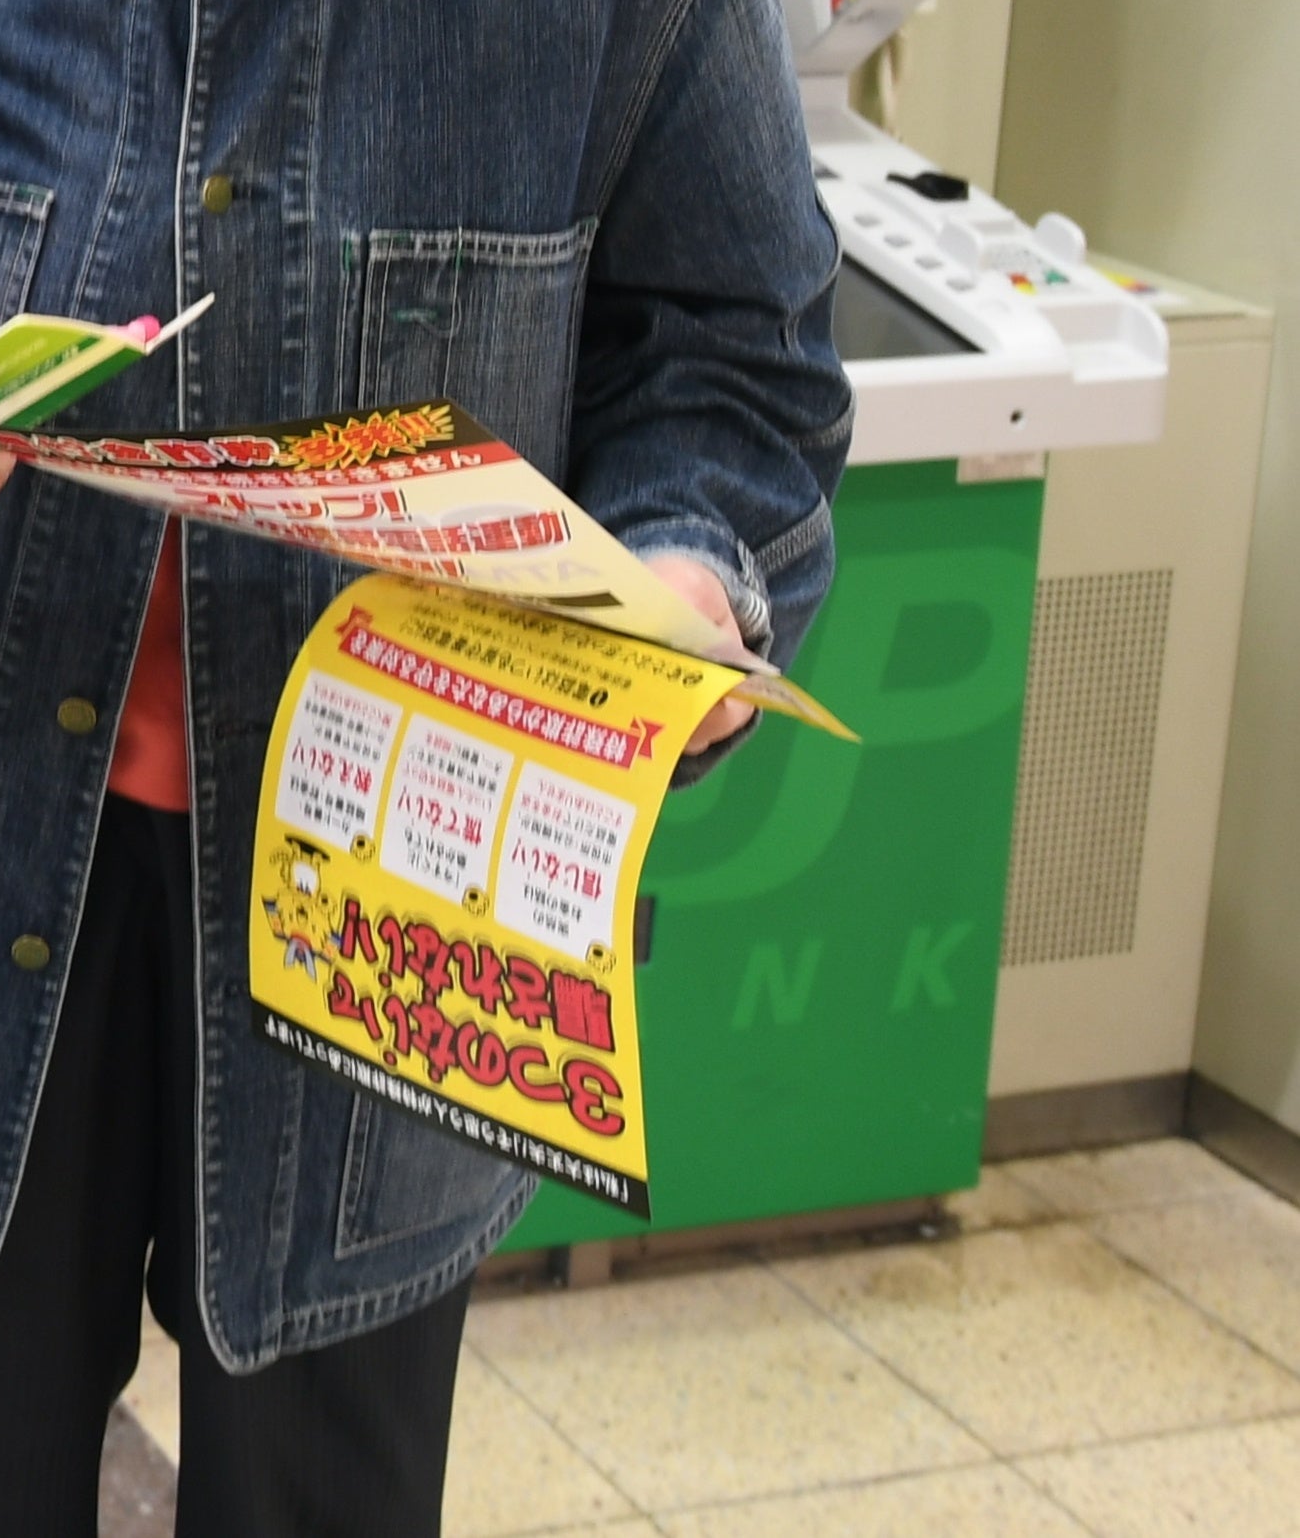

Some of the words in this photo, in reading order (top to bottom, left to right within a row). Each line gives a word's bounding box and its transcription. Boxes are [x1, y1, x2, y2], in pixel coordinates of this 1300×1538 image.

[511, 841, 603, 901] 信じない!
[328, 970, 626, 1138] 3つのないで
[341, 900, 617, 1054] 騙されない!
